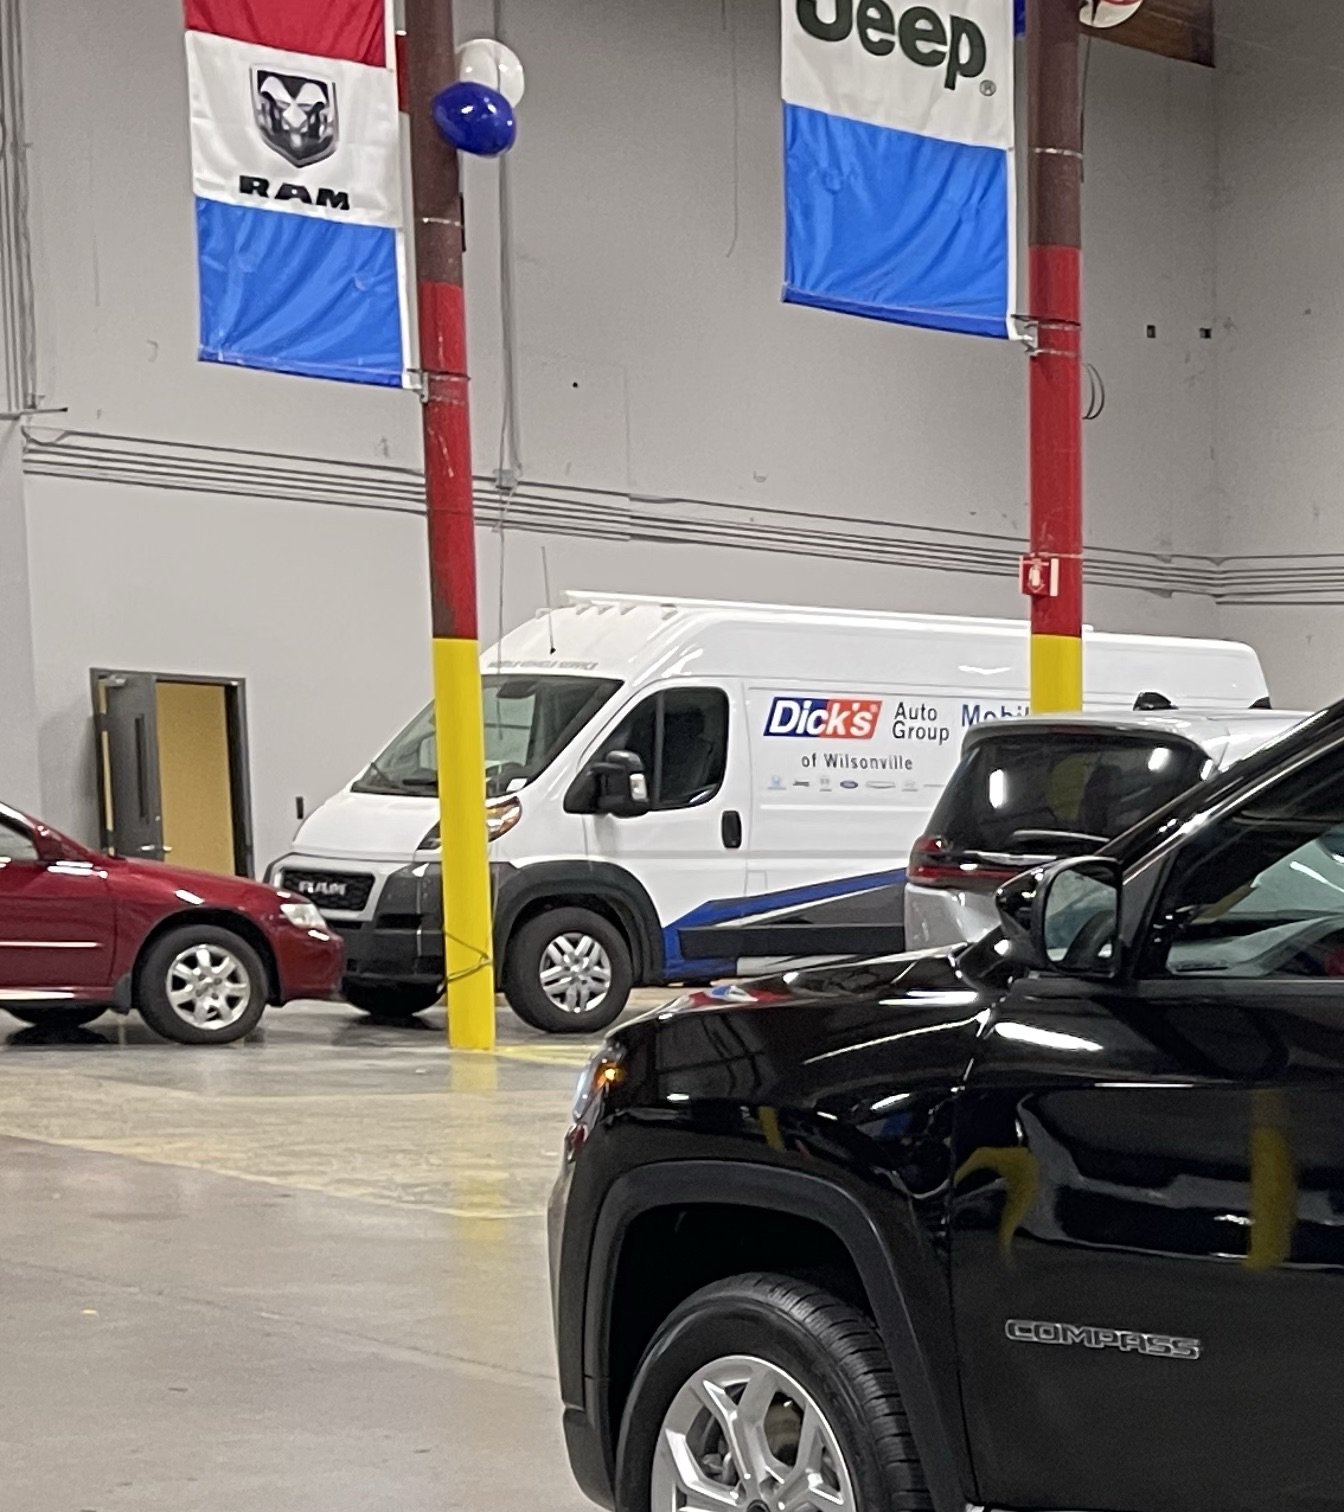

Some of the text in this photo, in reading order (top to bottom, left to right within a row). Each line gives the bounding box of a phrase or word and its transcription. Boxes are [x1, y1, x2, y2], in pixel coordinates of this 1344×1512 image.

[239, 175, 350, 210] RAM
[768, 699, 874, 737] Dick's
[894, 702, 938, 720] Auto
[892, 721, 950, 745] Group
[801, 753, 914, 770] of Wilsonville
[299, 881, 346, 896] RAM
[1005, 1319, 1200, 1360] COMPASS
